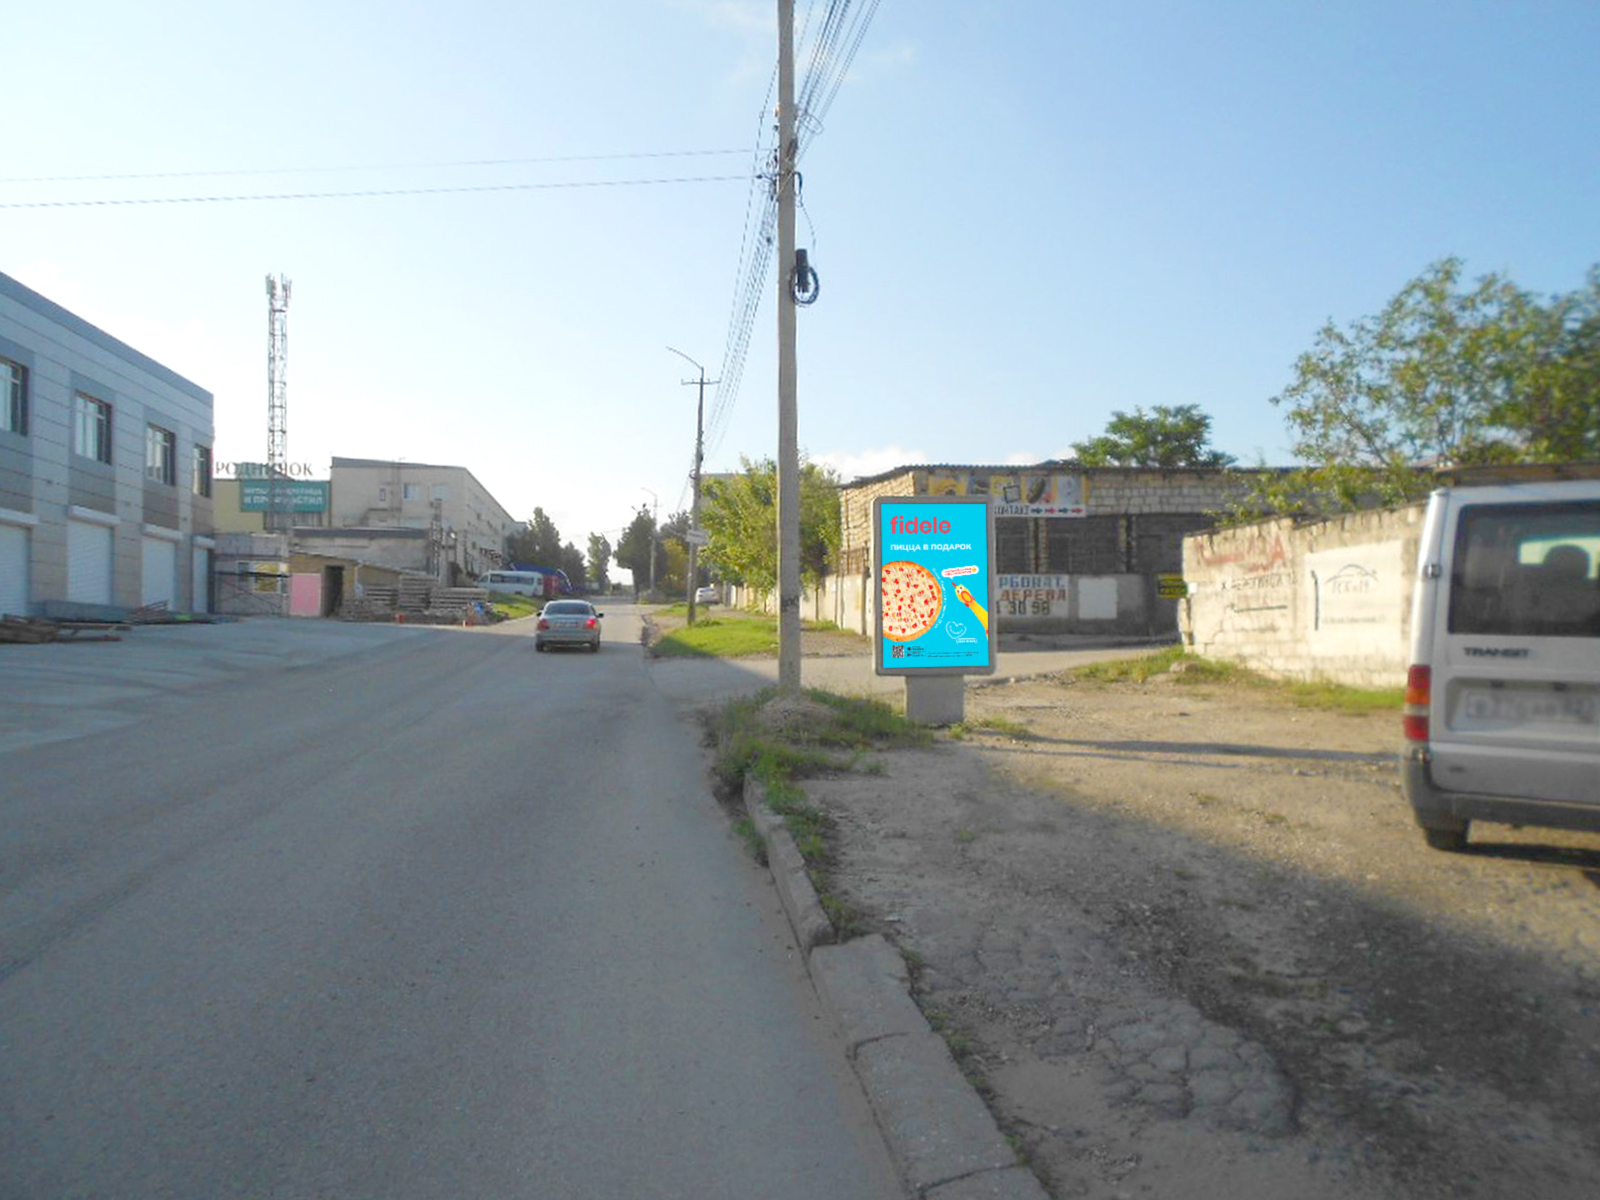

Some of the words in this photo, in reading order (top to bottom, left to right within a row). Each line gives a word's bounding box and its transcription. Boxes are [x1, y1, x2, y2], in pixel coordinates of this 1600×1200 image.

[890, 515, 951, 534] fidele
[890, 544, 921, 552] ПИЦЦА
[930, 543, 972, 552] ПОДАРОК
[1463, 646, 1530, 658] TRANSIT
